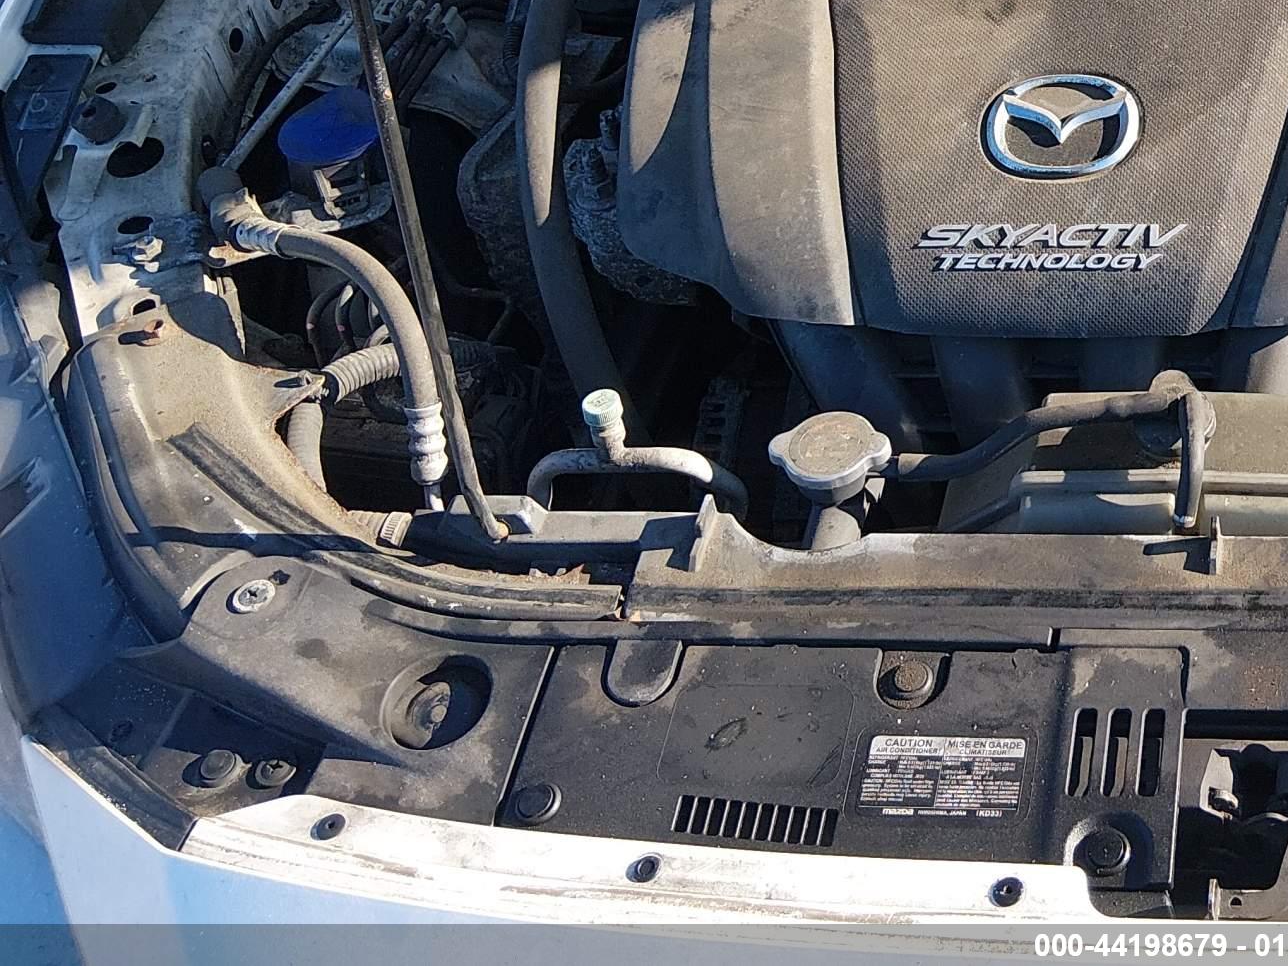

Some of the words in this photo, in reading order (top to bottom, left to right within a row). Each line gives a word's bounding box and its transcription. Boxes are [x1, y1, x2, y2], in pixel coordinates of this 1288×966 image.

[917, 223, 1188, 248] SKYACTIV
[937, 253, 1163, 271] TECHNOLOGY
[885, 738, 933, 748] CAUTION
[947, 740, 971, 748] MISE
[973, 740, 987, 748] EN
[989, 741, 1023, 750] GARDE
[882, 808, 914, 816] mazda
